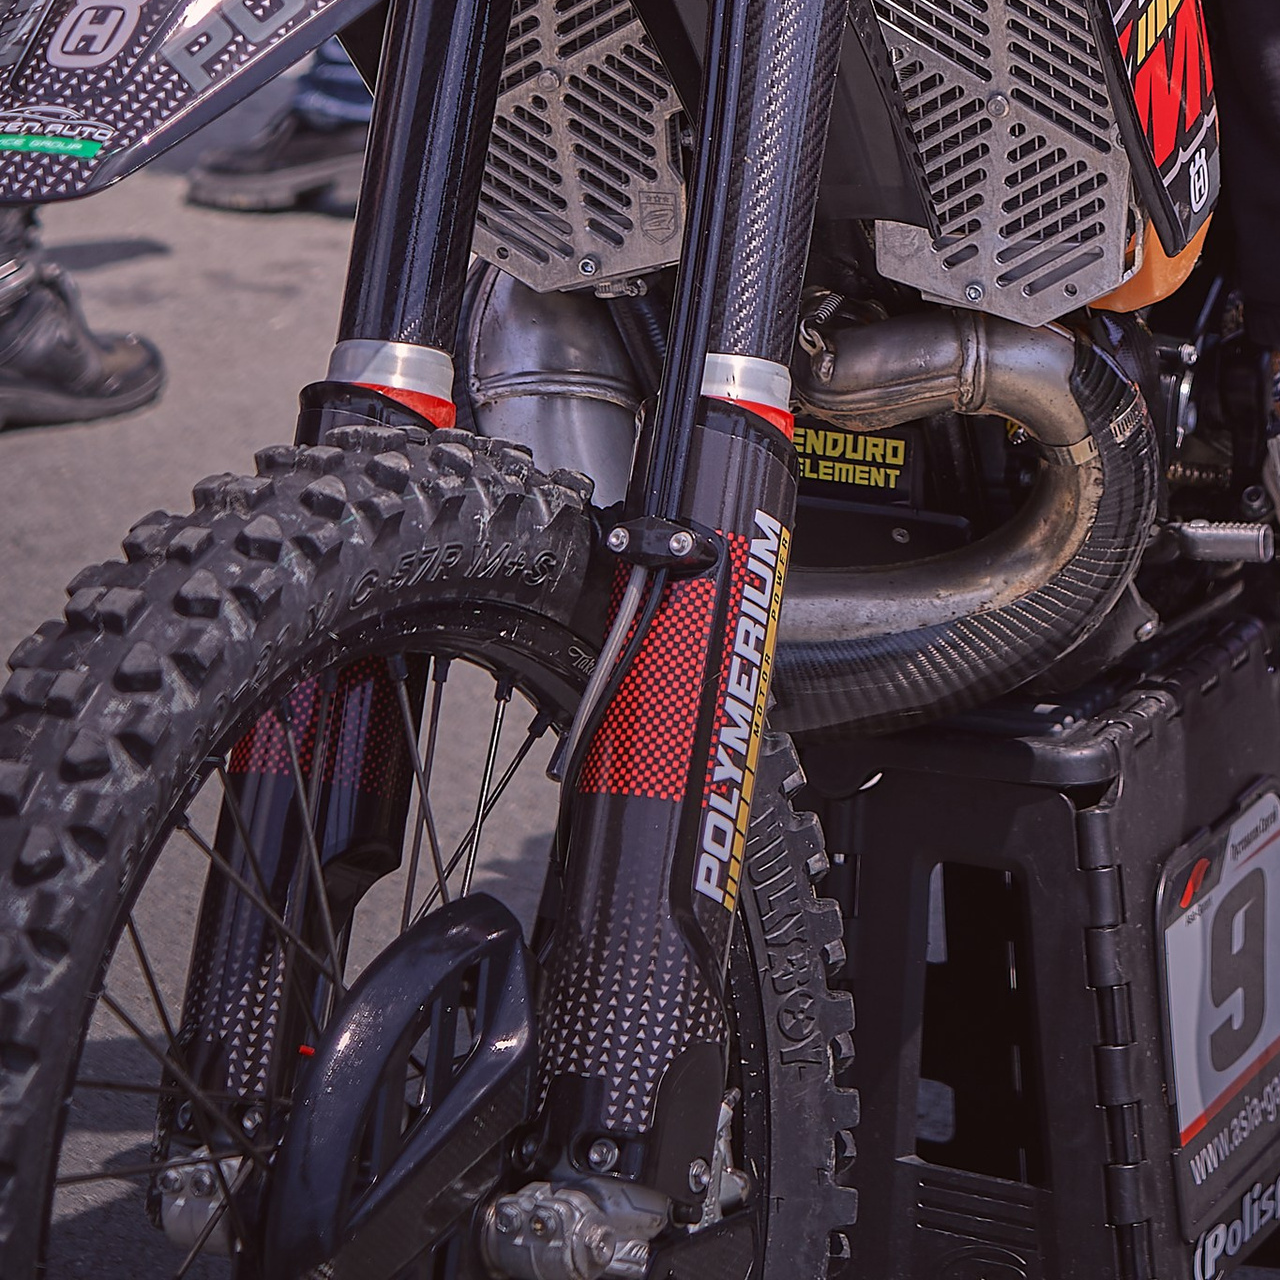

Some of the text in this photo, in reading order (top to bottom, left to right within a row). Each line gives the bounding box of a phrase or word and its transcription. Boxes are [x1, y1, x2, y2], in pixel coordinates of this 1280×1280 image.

[44, 122, 115, 142] AUTO
[793, 427, 906, 466] ENDURO
[695, 508, 782, 904] POLYMERIUM
[753, 535, 790, 739] MOTOR POWER
[1211, 867, 1267, 1073] 9
